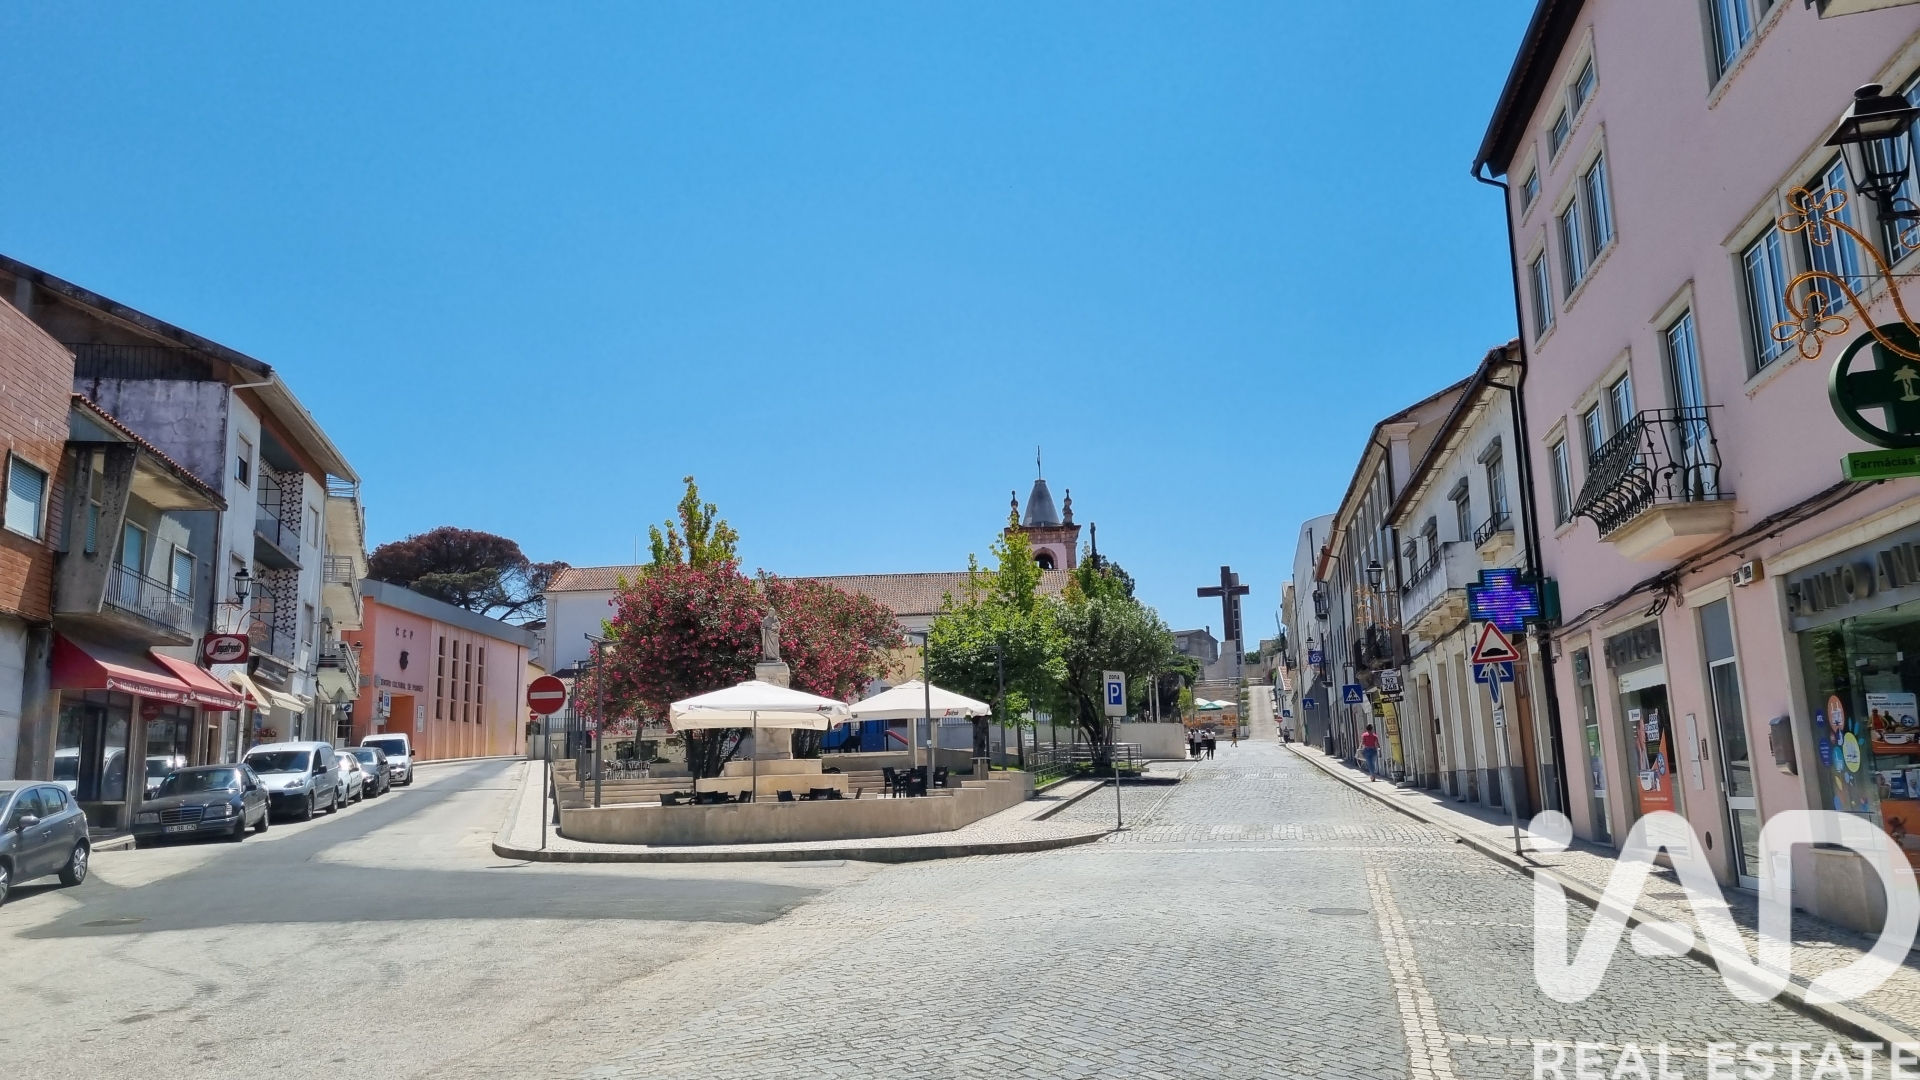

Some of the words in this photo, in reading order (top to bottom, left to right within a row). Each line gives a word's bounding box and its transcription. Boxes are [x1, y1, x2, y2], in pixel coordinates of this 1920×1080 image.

[1853, 457, 1915, 470] Farmácias
[1786, 562, 1873, 617] SANTO
[1110, 684, 1120, 704] P
